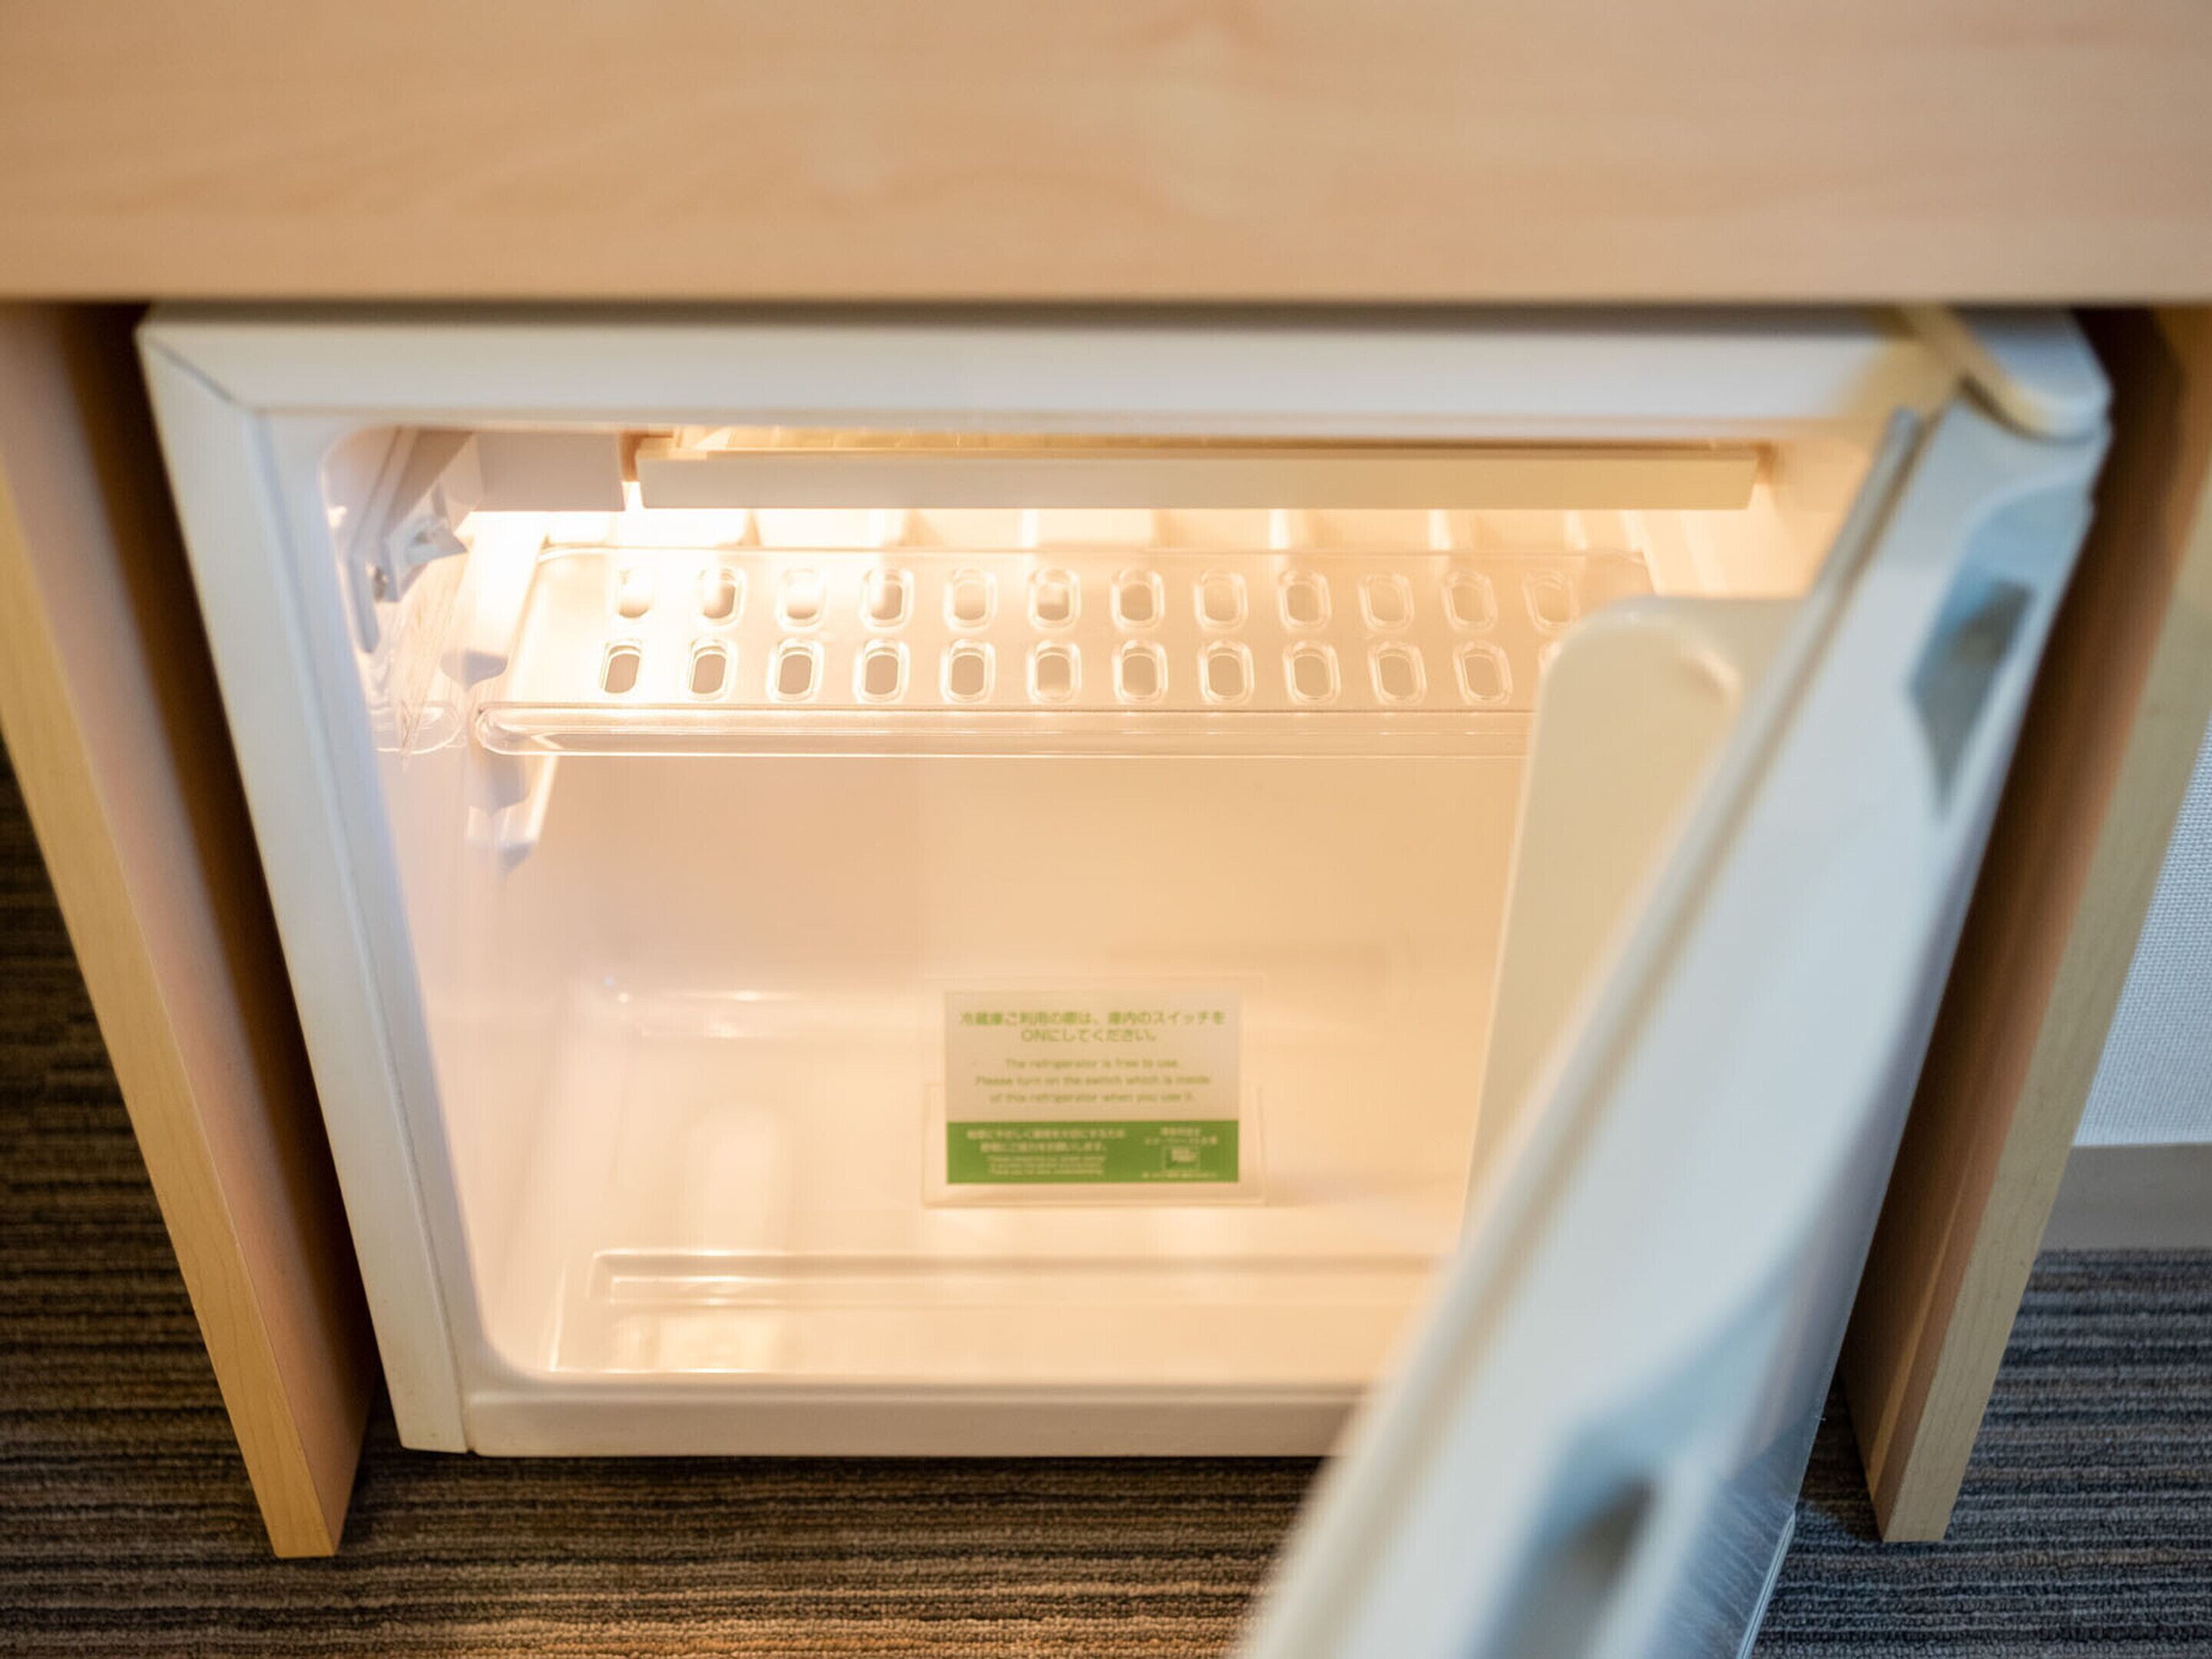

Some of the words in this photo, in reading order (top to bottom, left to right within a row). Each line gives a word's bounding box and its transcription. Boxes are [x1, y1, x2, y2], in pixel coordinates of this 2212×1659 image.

[1021, 1028, 1157, 1043] ONにしてください。
[1007, 1058, 1025, 1068] The
[1030, 1058, 1097, 1070] refrigerator
[1102, 1059, 1111, 1068] is
[1115, 1058, 1138, 1068] free
[1142, 1058, 1153, 1068] to
[975, 1075, 1013, 1086] Please
[1017, 1076, 1040, 1085] turn
[1043, 1077, 1059, 1085] on
[1062, 1075, 1081, 1085] the
[1084, 1075, 1122, 1085] switch
[1126, 1075, 1159, 1085] which
[1176, 1075, 1210, 1085] inside
[990, 1093, 1004, 1102] of
[1006, 1093, 1026, 1102] this
[1030, 1093, 1097, 1104] refrigerator
[1102, 1093, 1132, 1102] when
[1136, 1094, 1157, 1104] you
[1161, 1094, 1181, 1102] use
